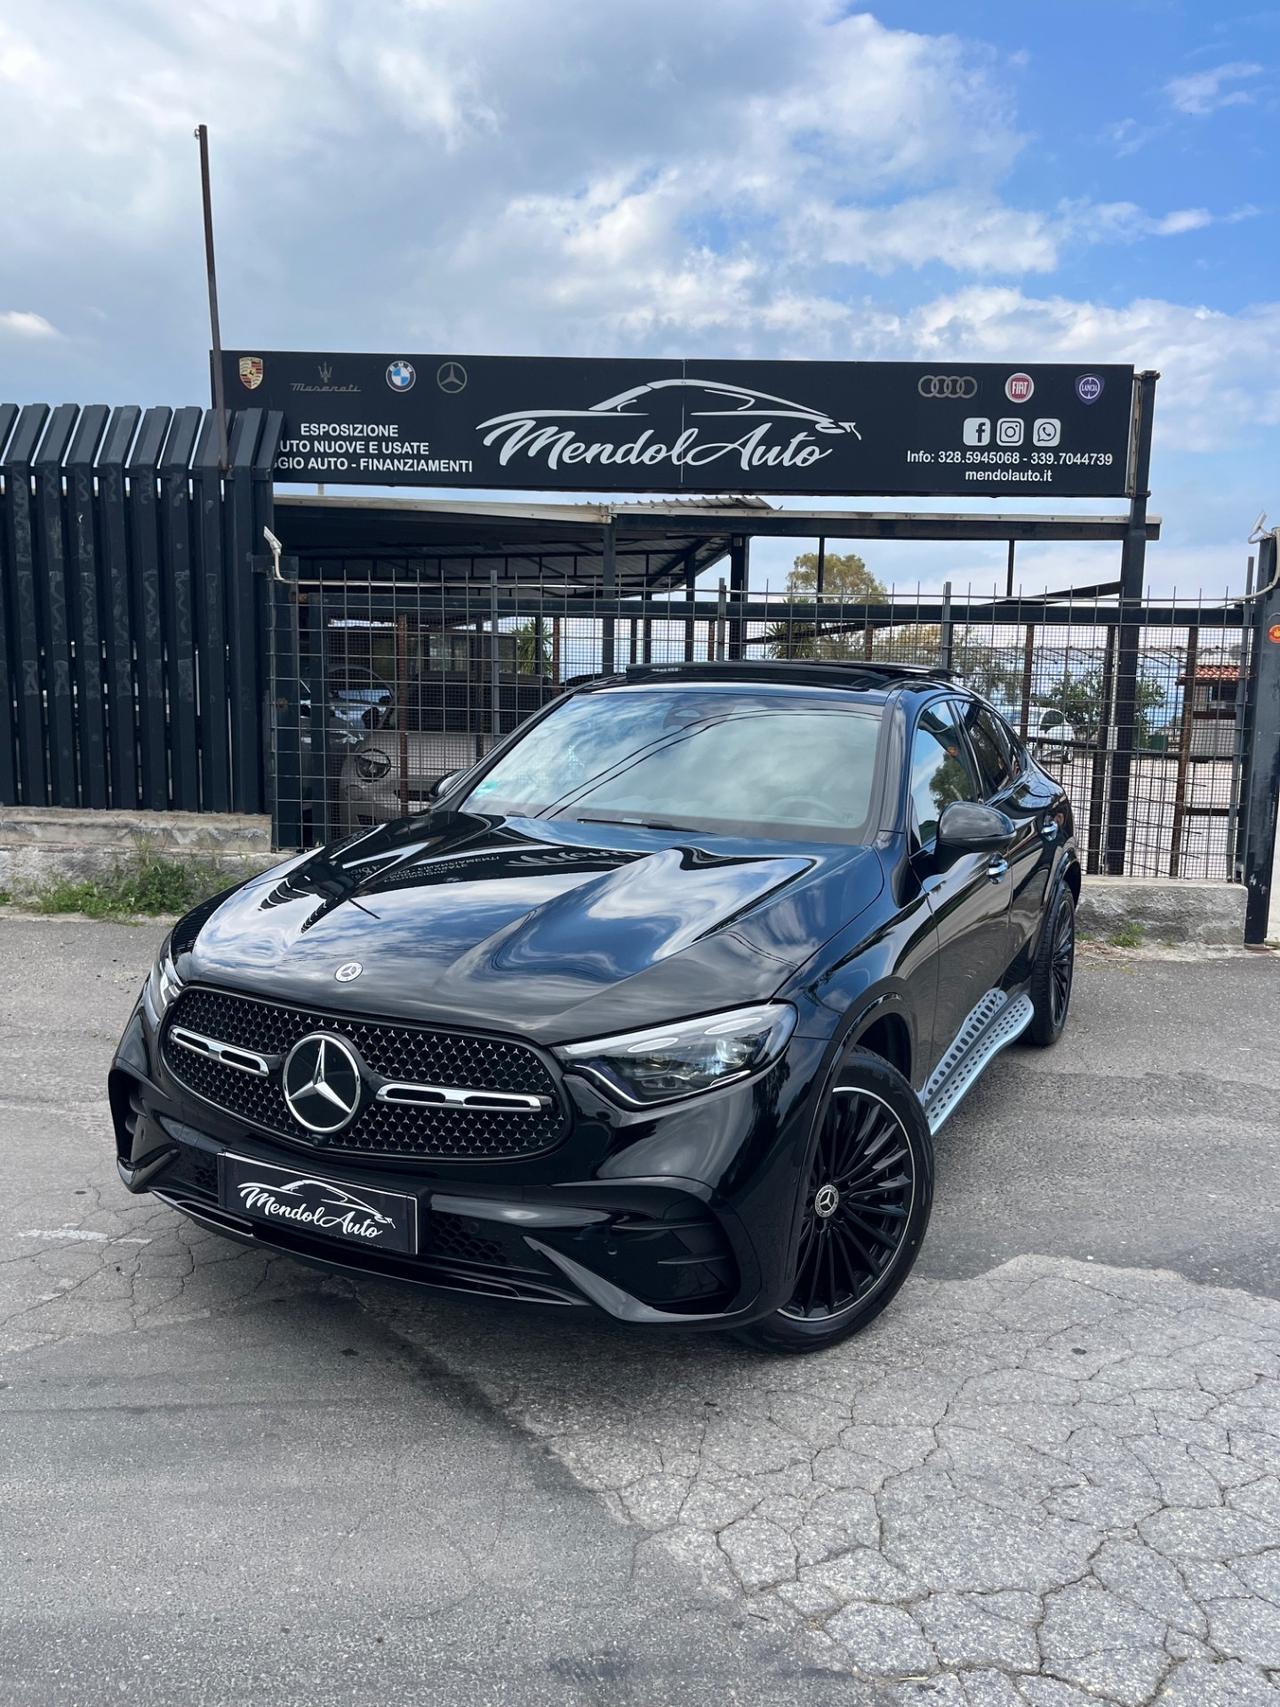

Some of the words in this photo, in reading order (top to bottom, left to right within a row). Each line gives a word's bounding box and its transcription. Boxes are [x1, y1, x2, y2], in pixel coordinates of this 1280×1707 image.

[1011, 380, 1029, 395] FIAT
[300, 423, 399, 437] ESPOSIZIONE
[278, 439, 310, 453] UTO
[313, 440, 366, 454] NUOVE
[369, 442, 379, 454] E
[382, 442, 429, 455] USATE
[307, 457, 349, 471] AUTO
[359, 458, 473, 473] FINANZIAMENTI
[906, 450, 935, 463] Info:
[937, 450, 1020, 465] 328.5945068
[1030, 452, 1113, 466] 339.7044739
[965, 468, 1053, 482] mendolauto.it
